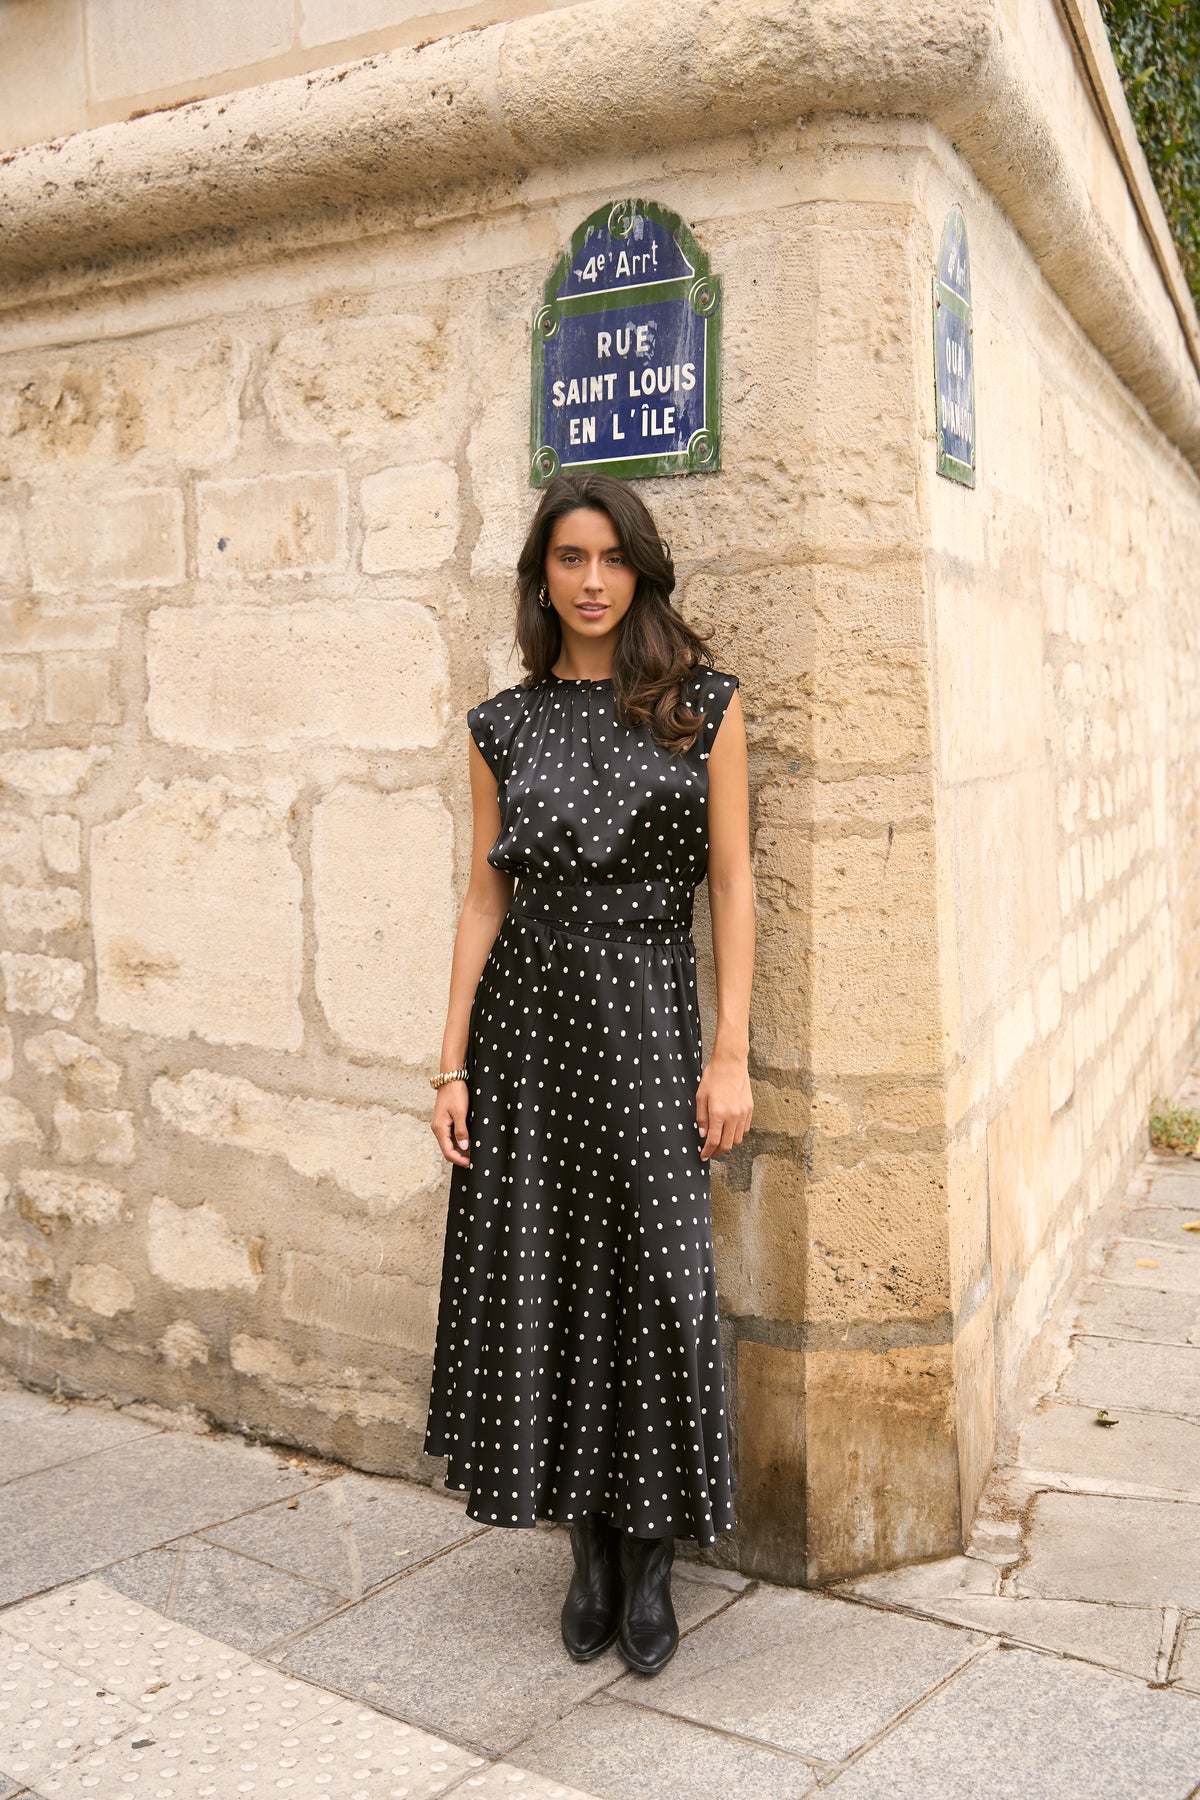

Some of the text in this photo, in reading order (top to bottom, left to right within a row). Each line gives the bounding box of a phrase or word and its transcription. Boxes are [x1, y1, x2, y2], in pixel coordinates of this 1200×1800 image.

[597, 325, 650, 359] RUE
[945, 336, 966, 380] QUAI
[552, 363, 696, 407] SAINT LOUIS
[570, 416, 596, 445] EN
